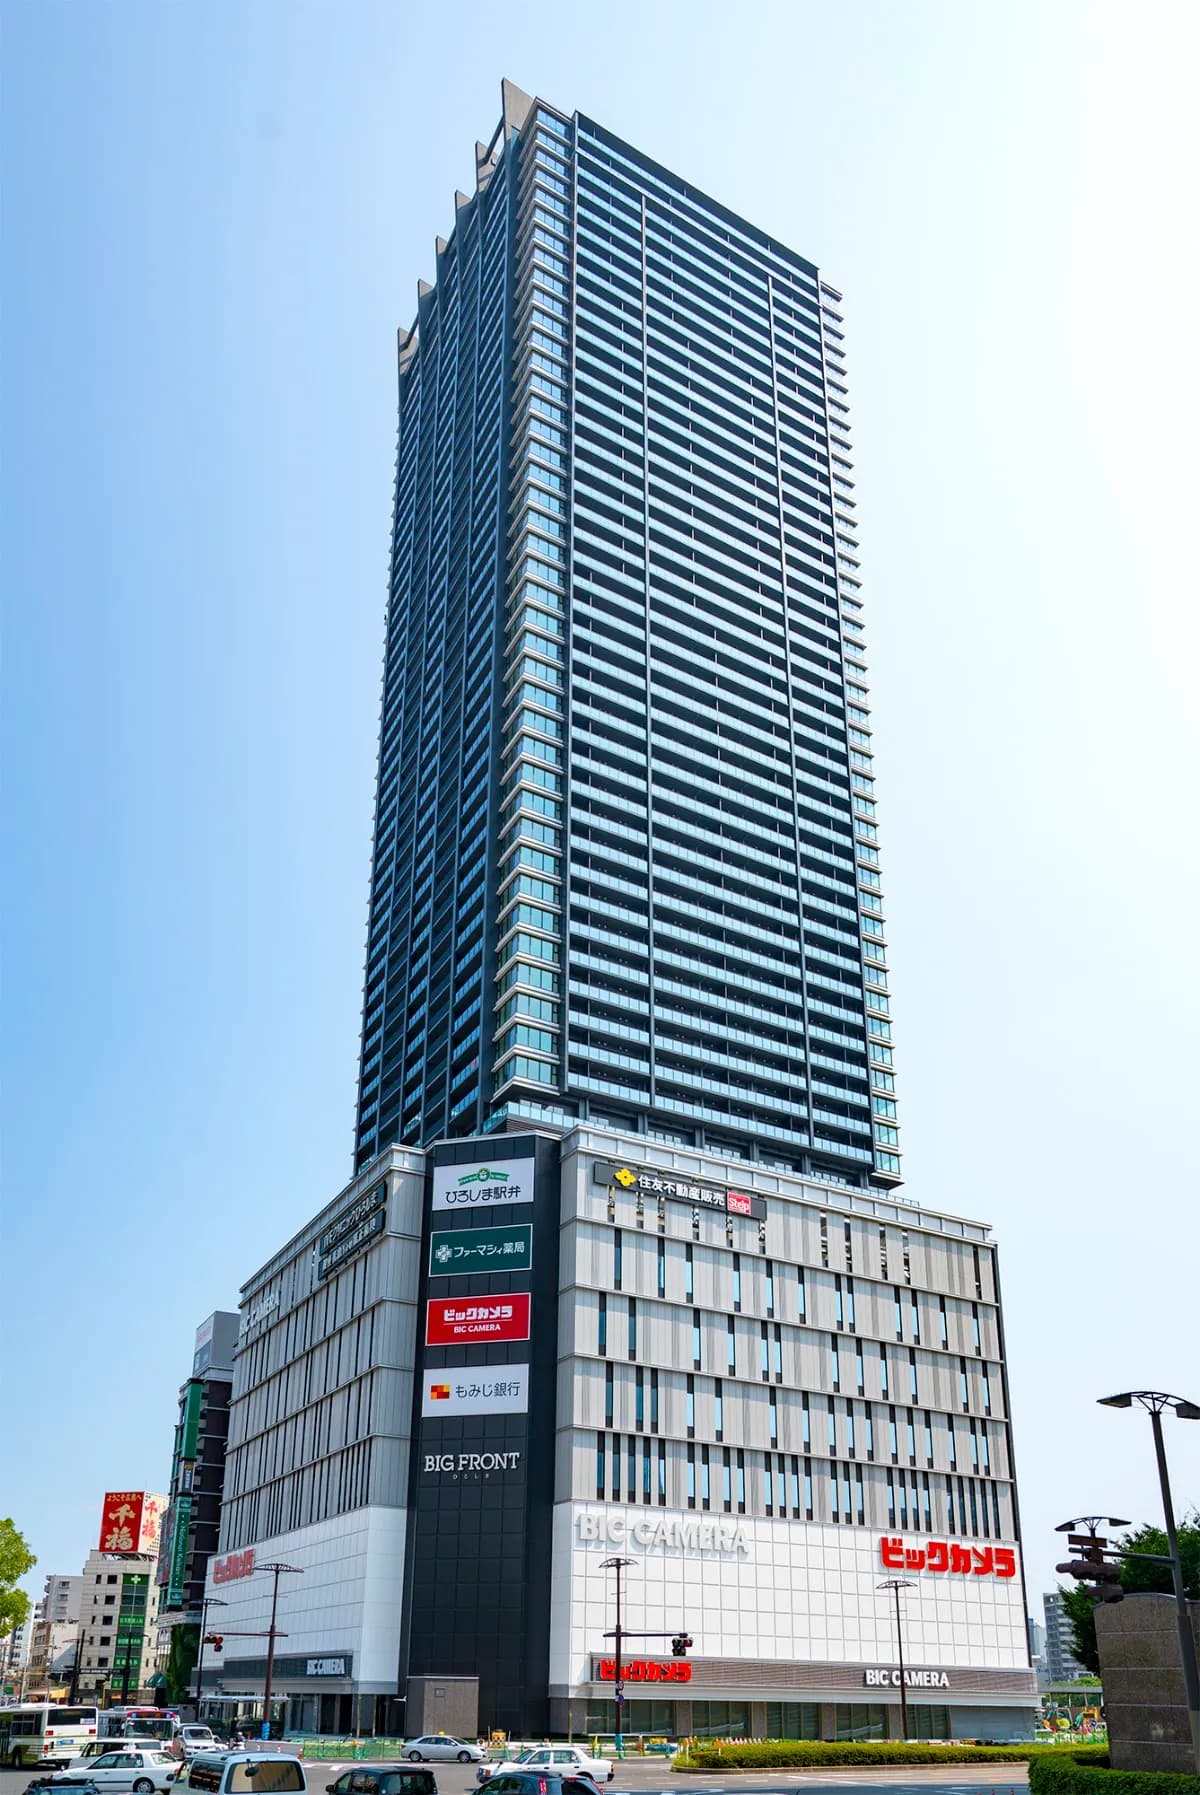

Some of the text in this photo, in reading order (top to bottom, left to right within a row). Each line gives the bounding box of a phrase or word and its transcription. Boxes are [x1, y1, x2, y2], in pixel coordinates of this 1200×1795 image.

[445, 1185, 522, 1203] ひろしま駅弁
[638, 1174, 726, 1206] 住友不動産販売
[453, 1241, 525, 1258] ファーマシィ薬局
[443, 1305, 513, 1322] ビックカメラ
[453, 1323, 501, 1334] BIC CAMERA
[455, 1381, 521, 1399] もみじ銀行
[424, 1452, 520, 1472] BIG FRONT
[104, 1503, 136, 1551] 千福
[579, 1513, 751, 1553] BIC CAMERA
[880, 1536, 1016, 1578] ビックカメラ
[865, 1669, 951, 1687] BIC CAMERA
